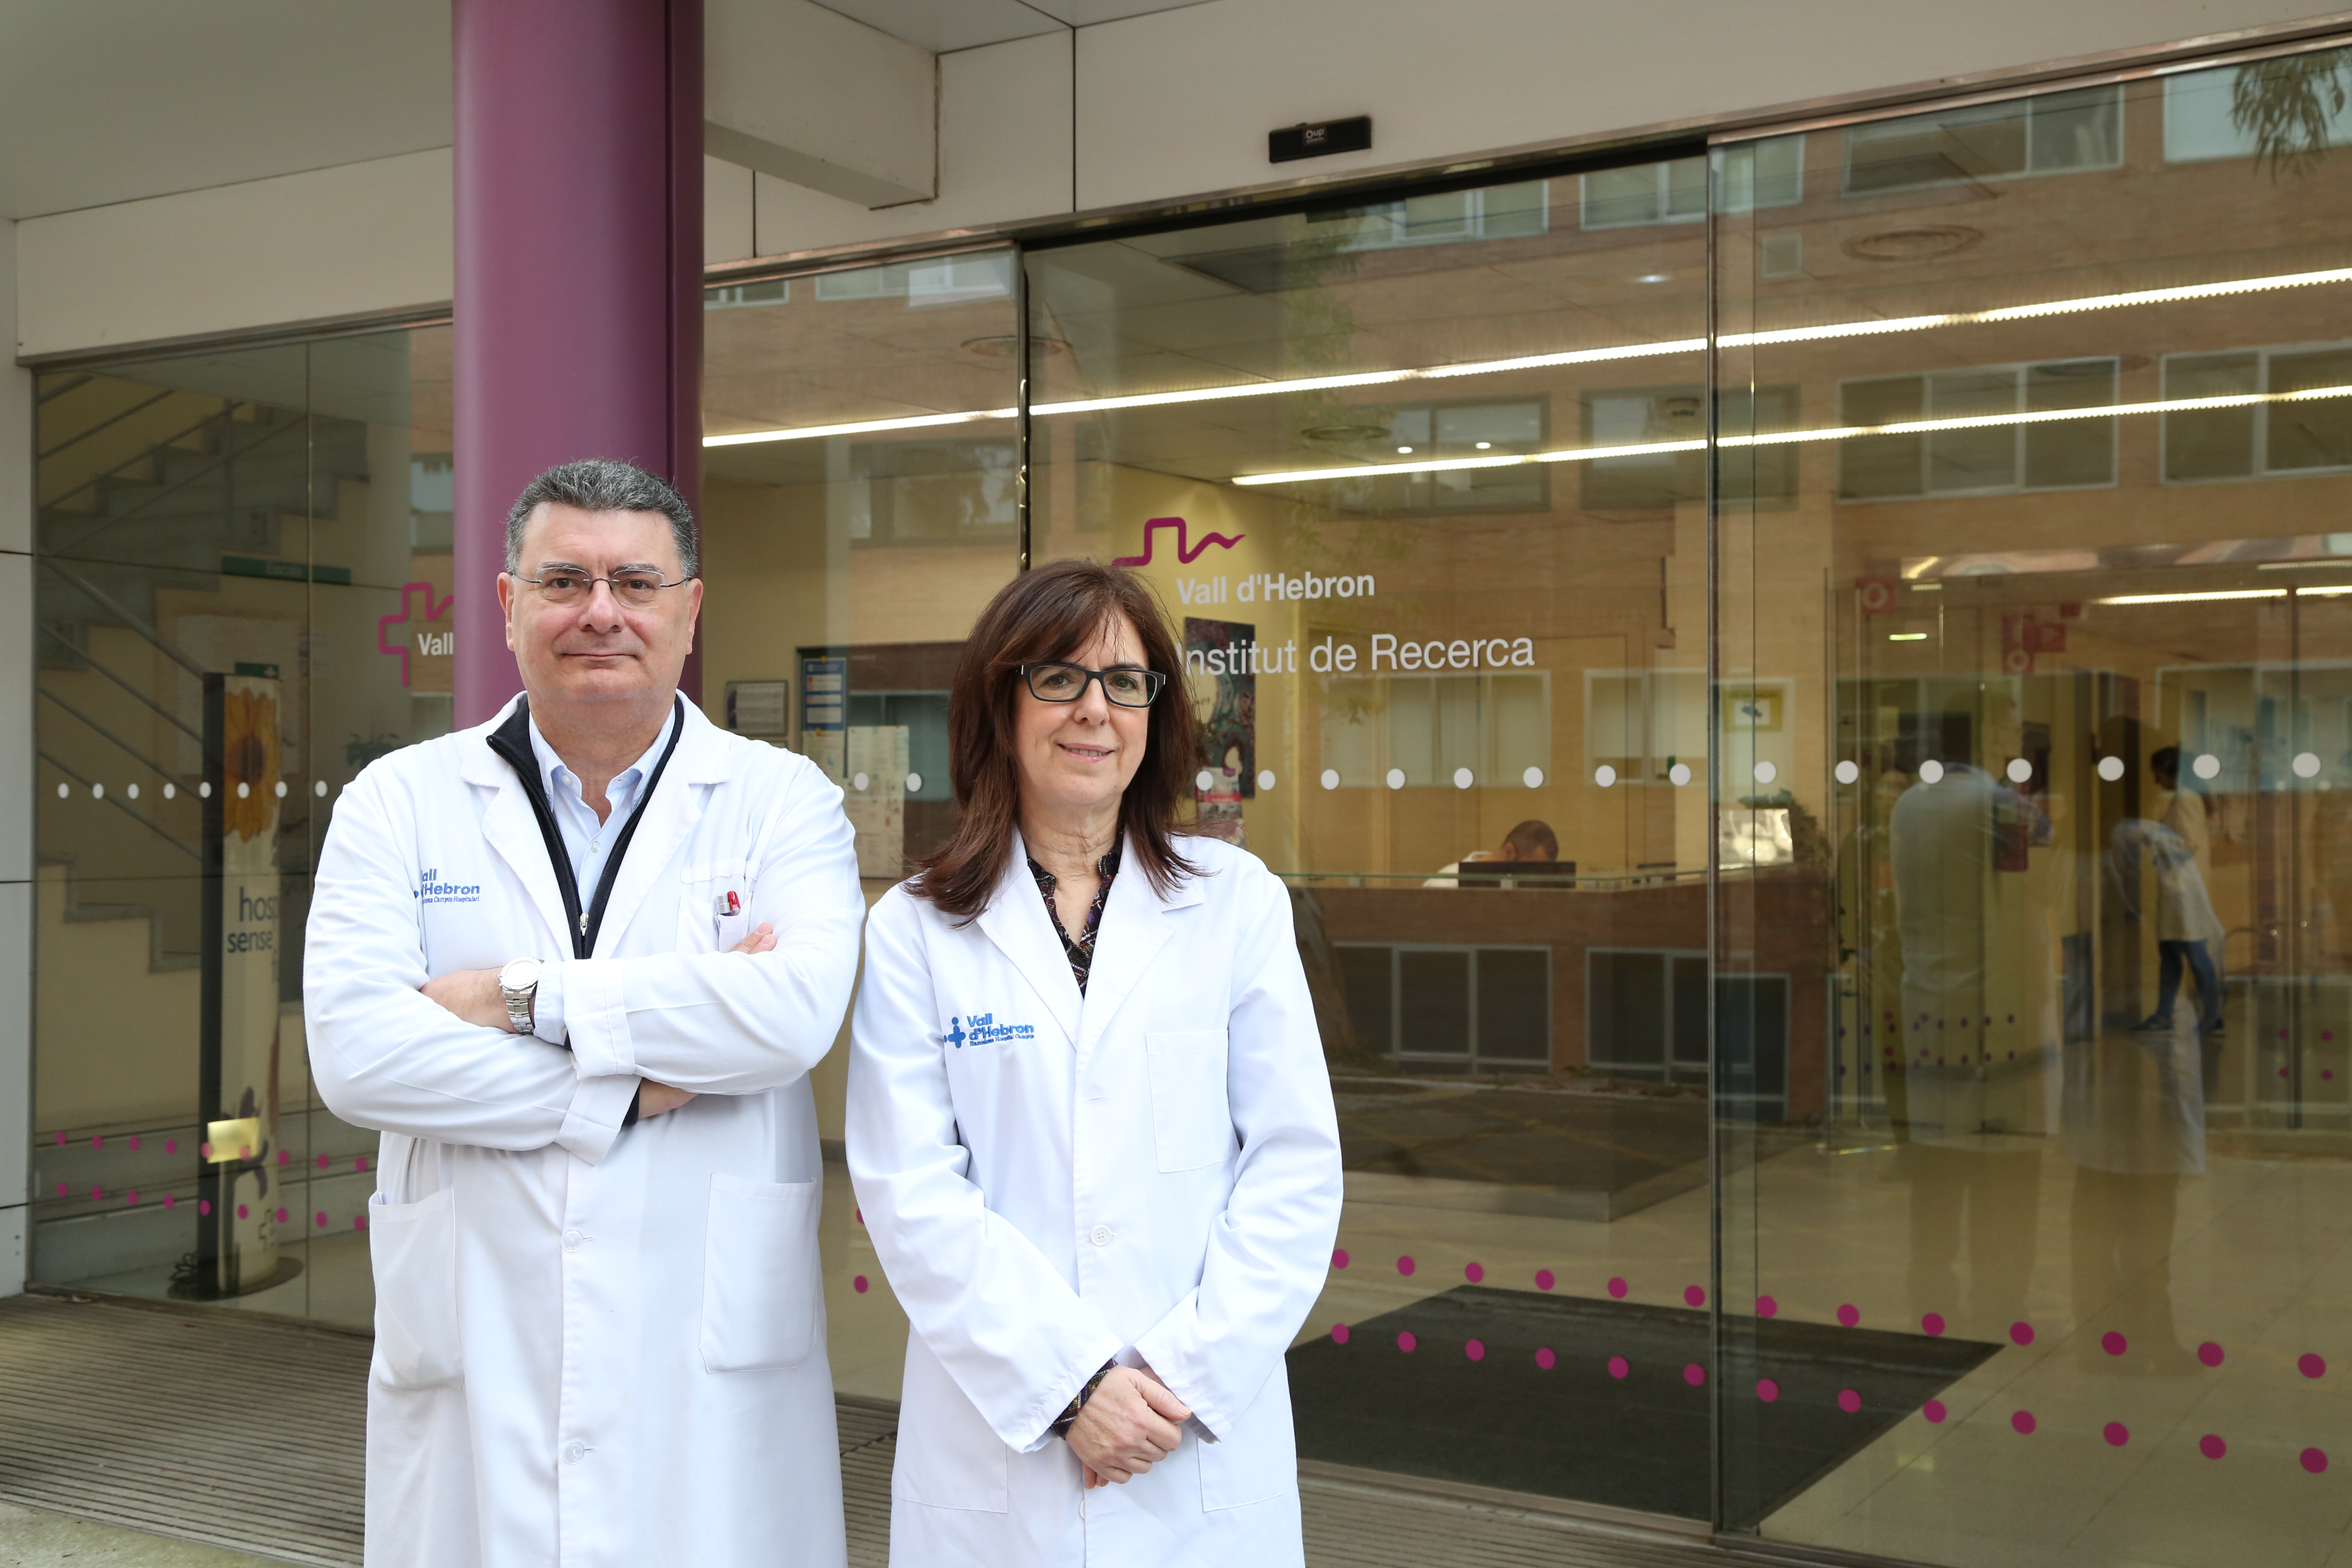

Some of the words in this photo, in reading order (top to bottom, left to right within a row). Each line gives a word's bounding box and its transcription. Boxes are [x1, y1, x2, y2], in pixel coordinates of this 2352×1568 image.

[1176, 576, 1226, 605] Vall
[1236, 571, 1375, 602] d'Hebron
[417, 632, 454, 655] Vall
[1310, 636, 1356, 673] de
[1371, 633, 1535, 670] Recerca
[421, 869, 437, 882] all
[967, 1013, 993, 1027] Vall
[969, 1024, 1034, 1040] d'Hebron
